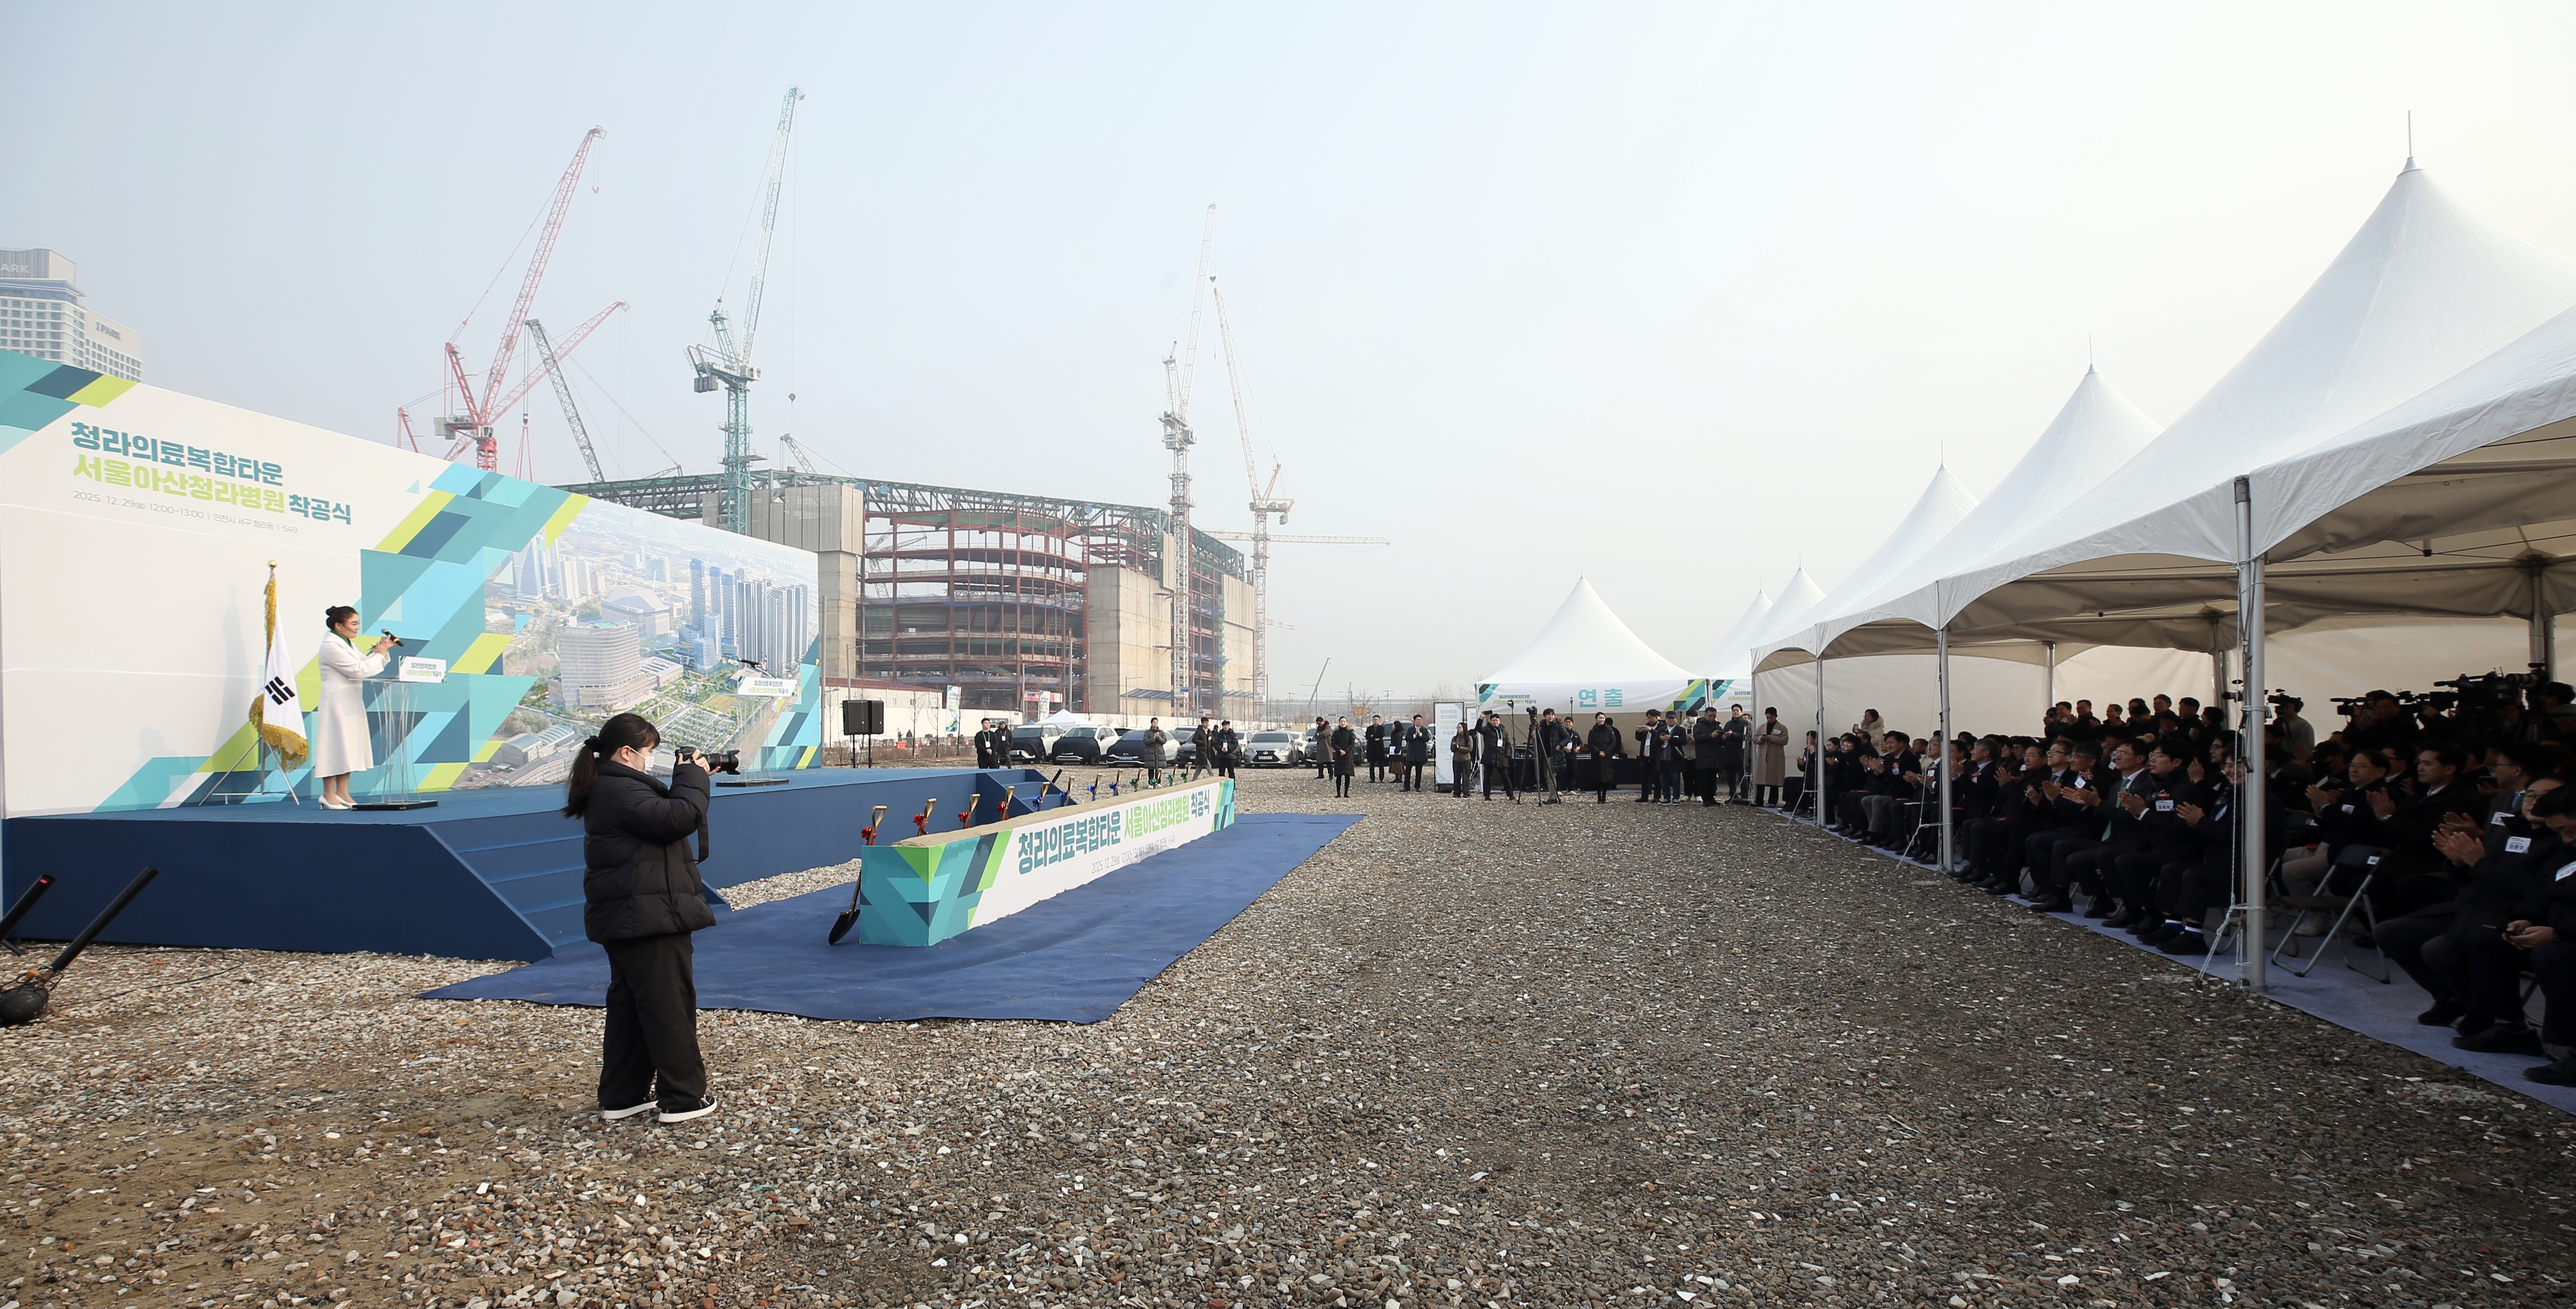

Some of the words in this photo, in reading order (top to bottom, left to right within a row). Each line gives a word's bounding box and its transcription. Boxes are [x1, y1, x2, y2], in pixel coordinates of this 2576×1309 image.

[71, 421, 283, 487] 청라의료복합타운
[73, 454, 285, 513] 서울아산청라병원
[289, 494, 352, 525] 착공식
[73, 491, 103, 503] 2025.
[106, 496, 120, 505] 12.
[149, 503, 204, 518] 12:00~13:00
[213, 513, 236, 524] 인천시
[253, 520, 274, 530] 청라동
[276, 524, 298, 533] 1-549
[1018, 811, 1121, 875] 청라의료복합타운
[1125, 795, 1189, 840] 서울아산청라병원
[1191, 789, 1209, 818] 착공식
[1092, 861, 1104, 874] 2025.
